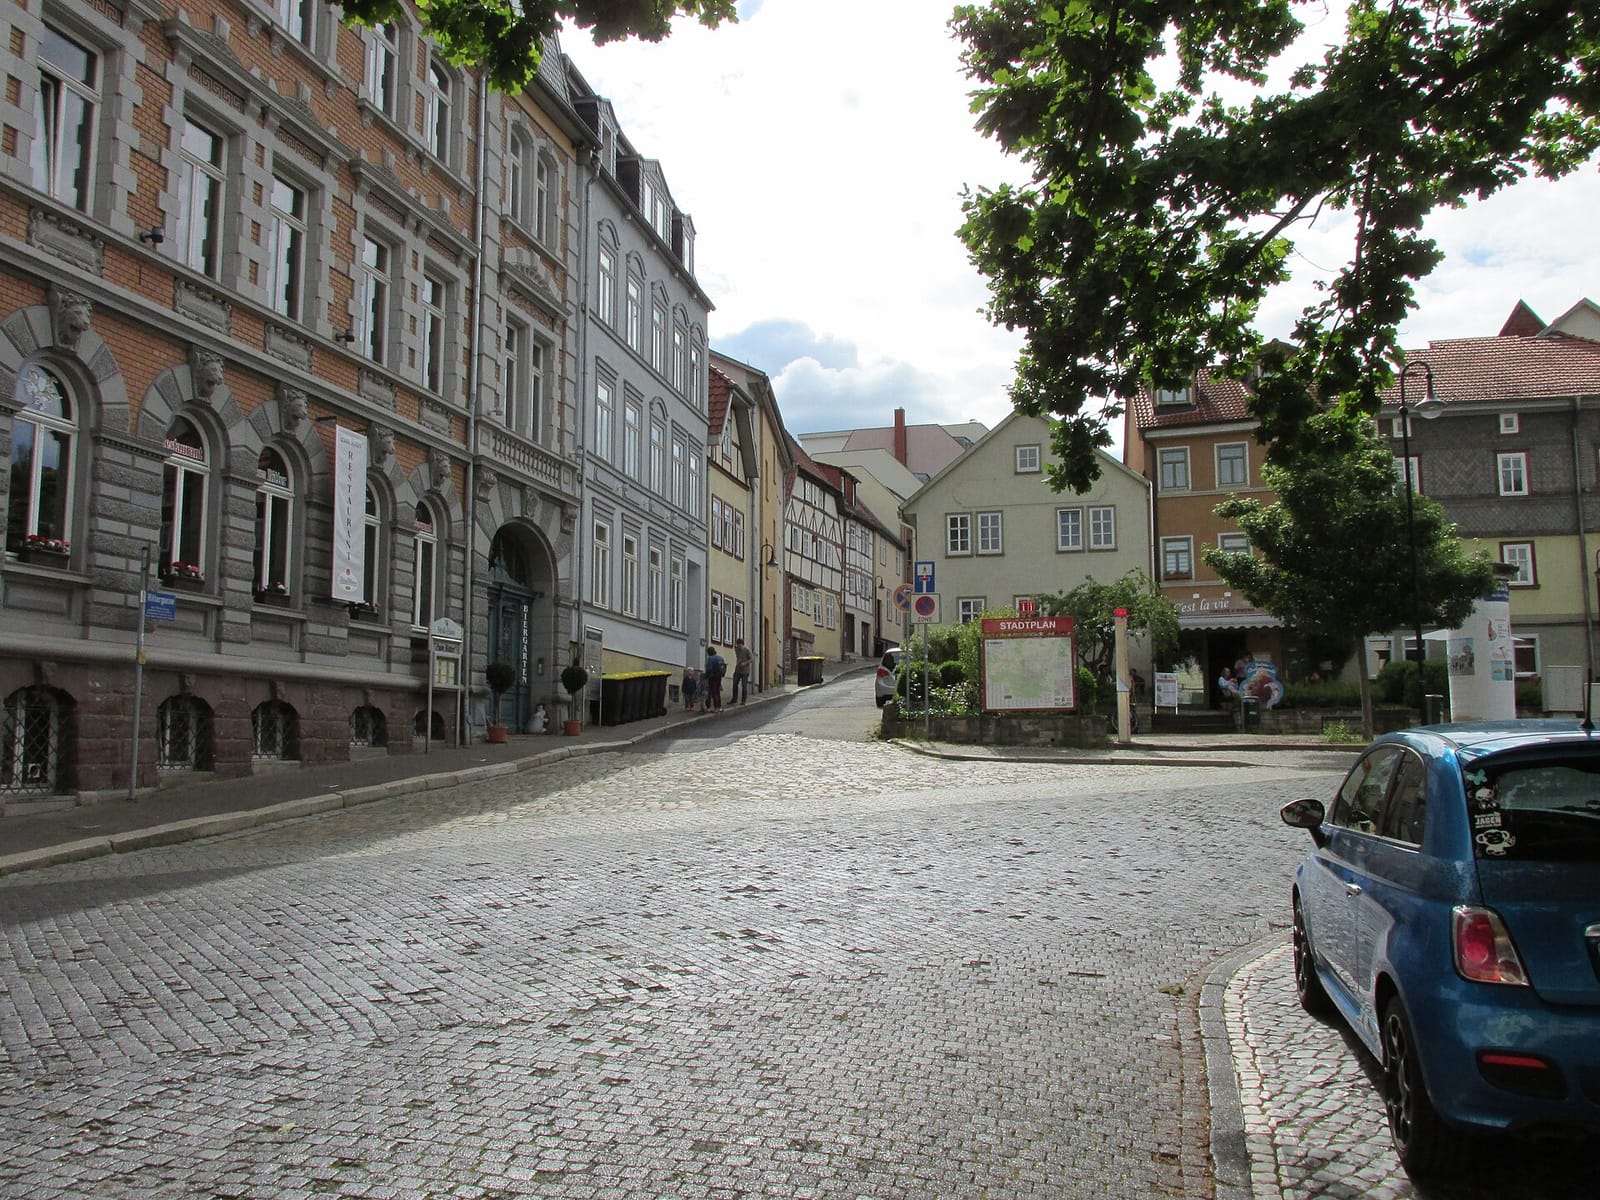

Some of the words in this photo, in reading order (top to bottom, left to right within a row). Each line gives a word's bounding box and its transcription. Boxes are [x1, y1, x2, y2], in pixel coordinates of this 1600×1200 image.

[345, 449, 353, 560] RESTAURANT
[1200, 599, 1209, 610] la
[1214, 597, 1229, 608] vie
[999, 621, 1056, 631] STADTPLAN
